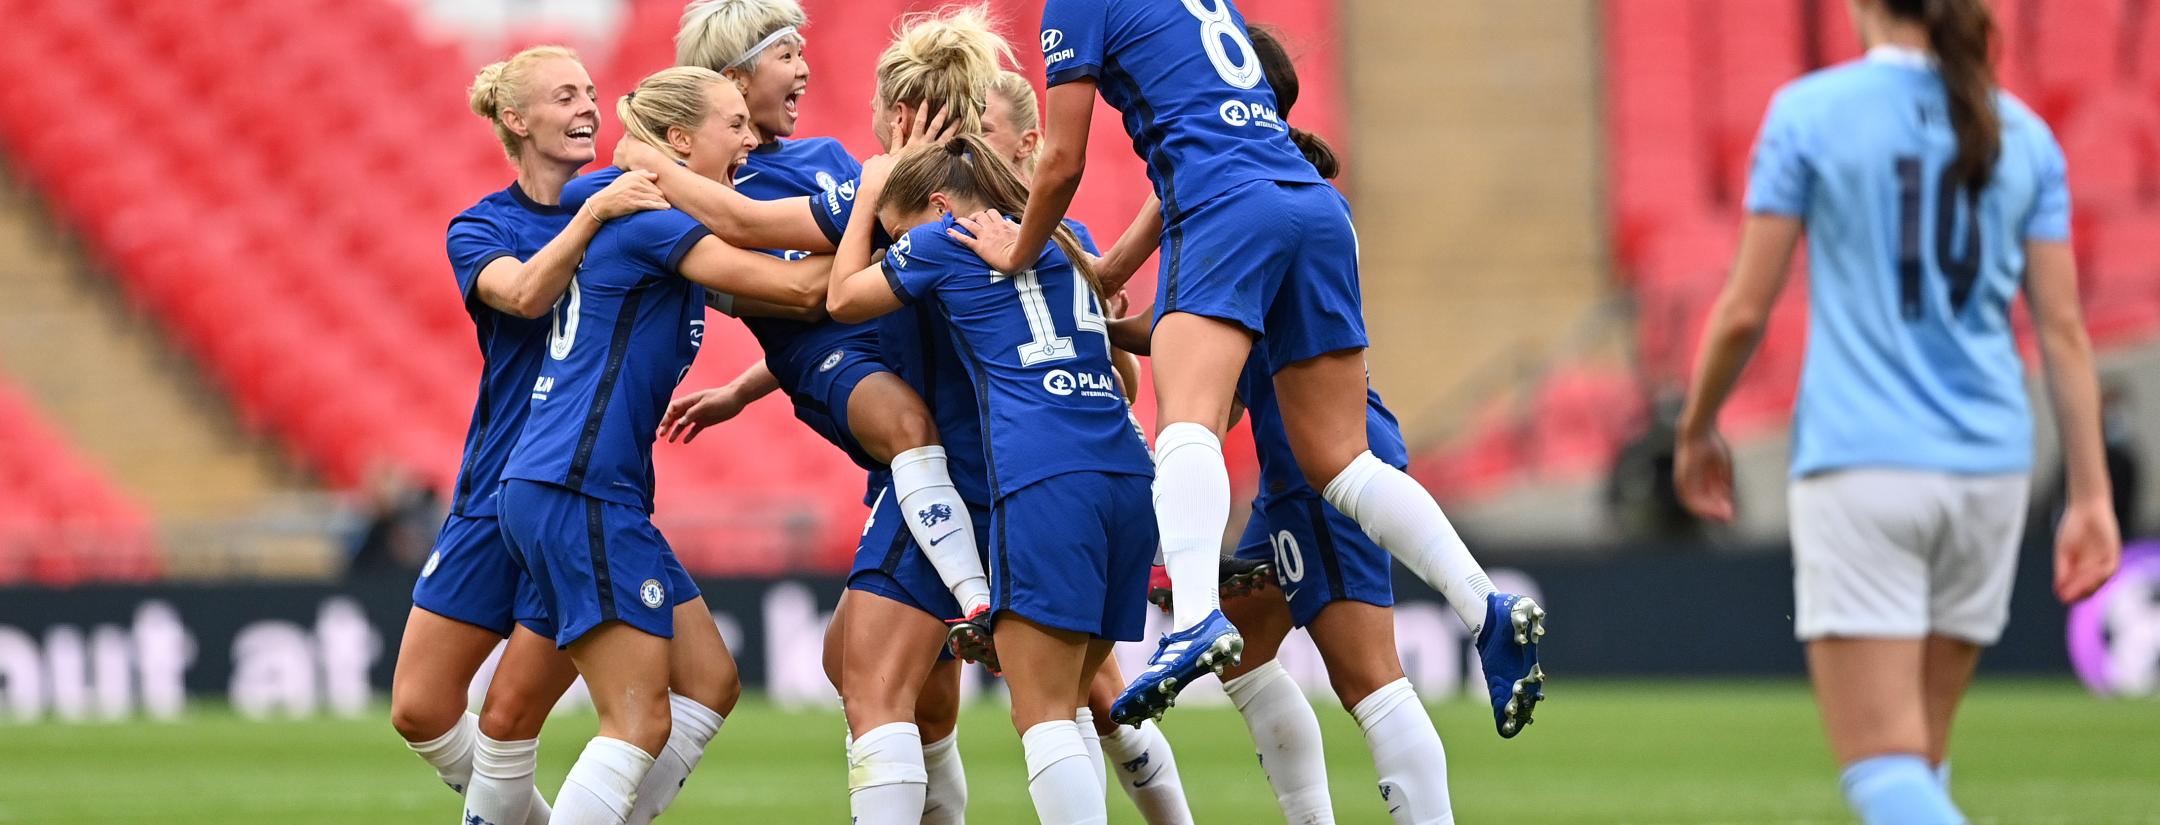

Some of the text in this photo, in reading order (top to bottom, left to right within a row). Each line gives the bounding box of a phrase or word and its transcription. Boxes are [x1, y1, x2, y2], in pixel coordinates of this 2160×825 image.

[1182, 0, 1262, 90] 8
[990, 266, 1113, 368] 14
[229, 597, 383, 722] at
